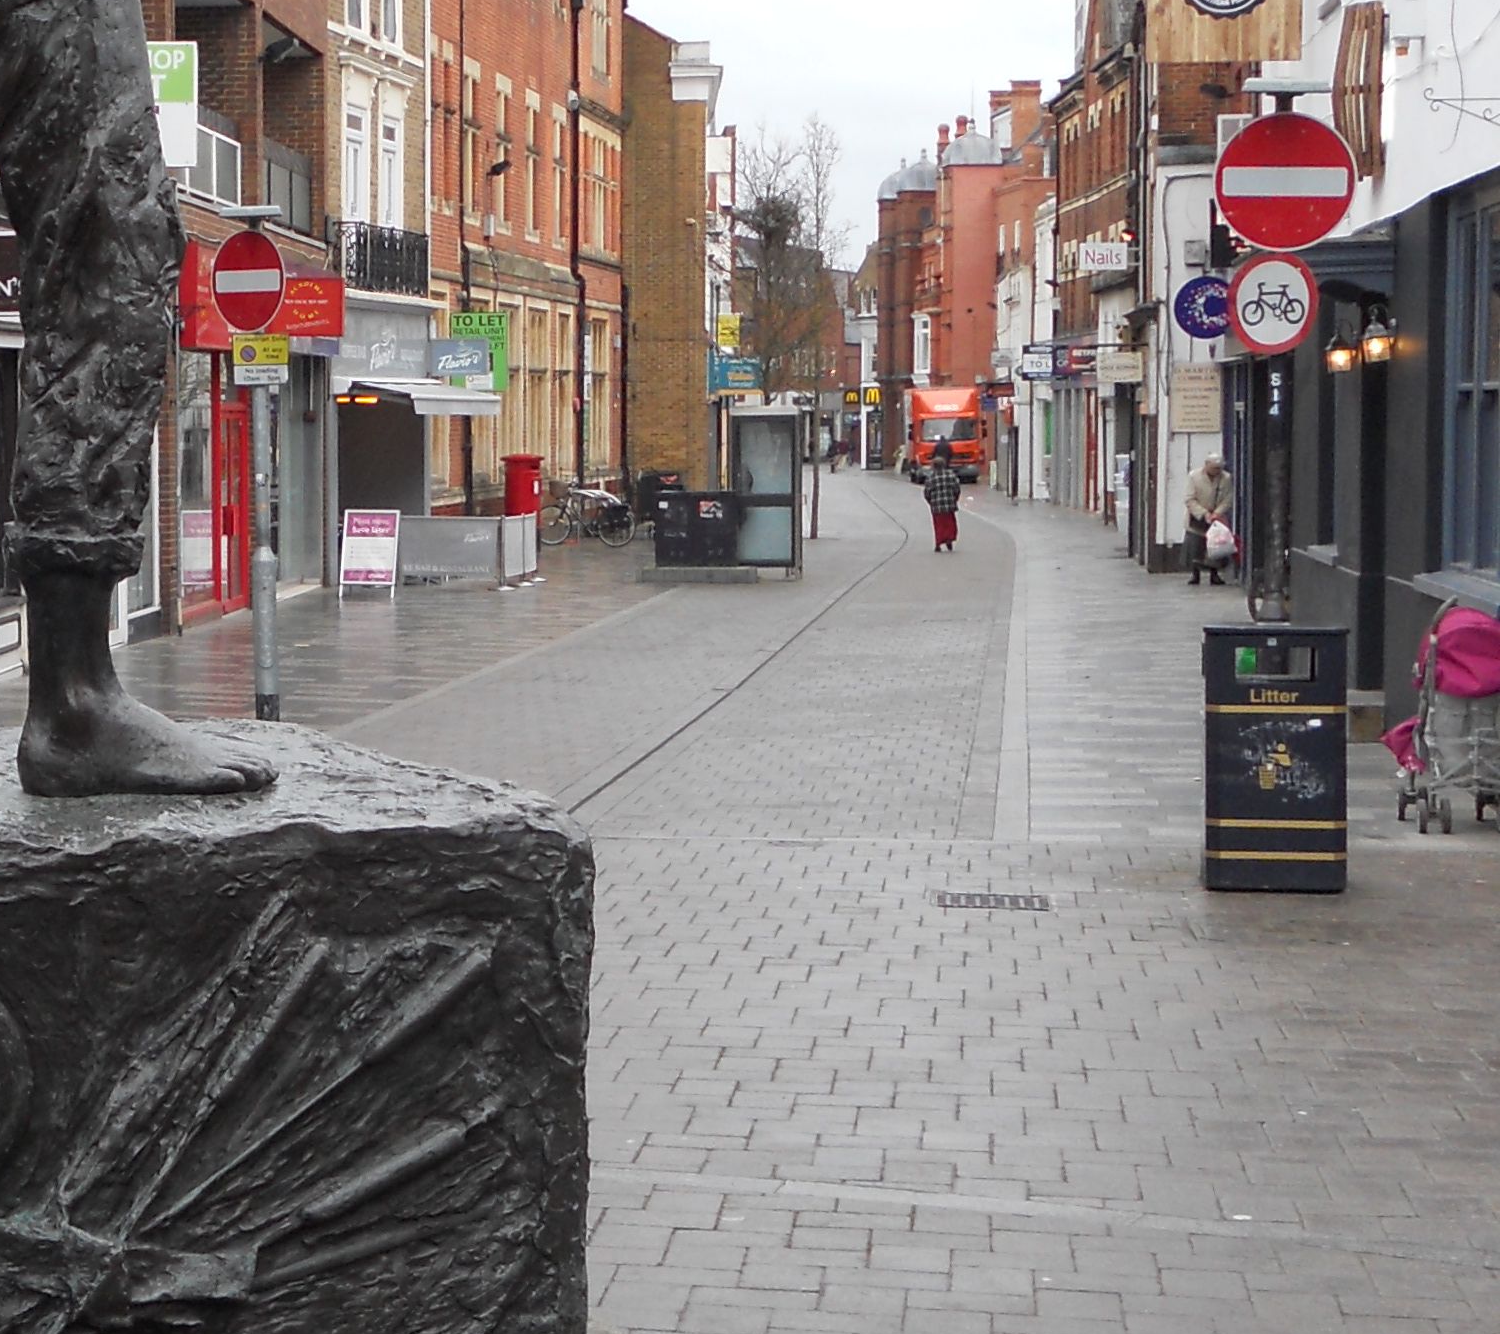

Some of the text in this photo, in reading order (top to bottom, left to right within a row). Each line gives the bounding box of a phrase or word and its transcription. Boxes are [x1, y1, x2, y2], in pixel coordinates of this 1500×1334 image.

[1084, 249, 1122, 266] Nails
[453, 314, 505, 327] TO LET
[484, 327, 504, 335] UNIT
[1250, 688, 1299, 703] Litter
